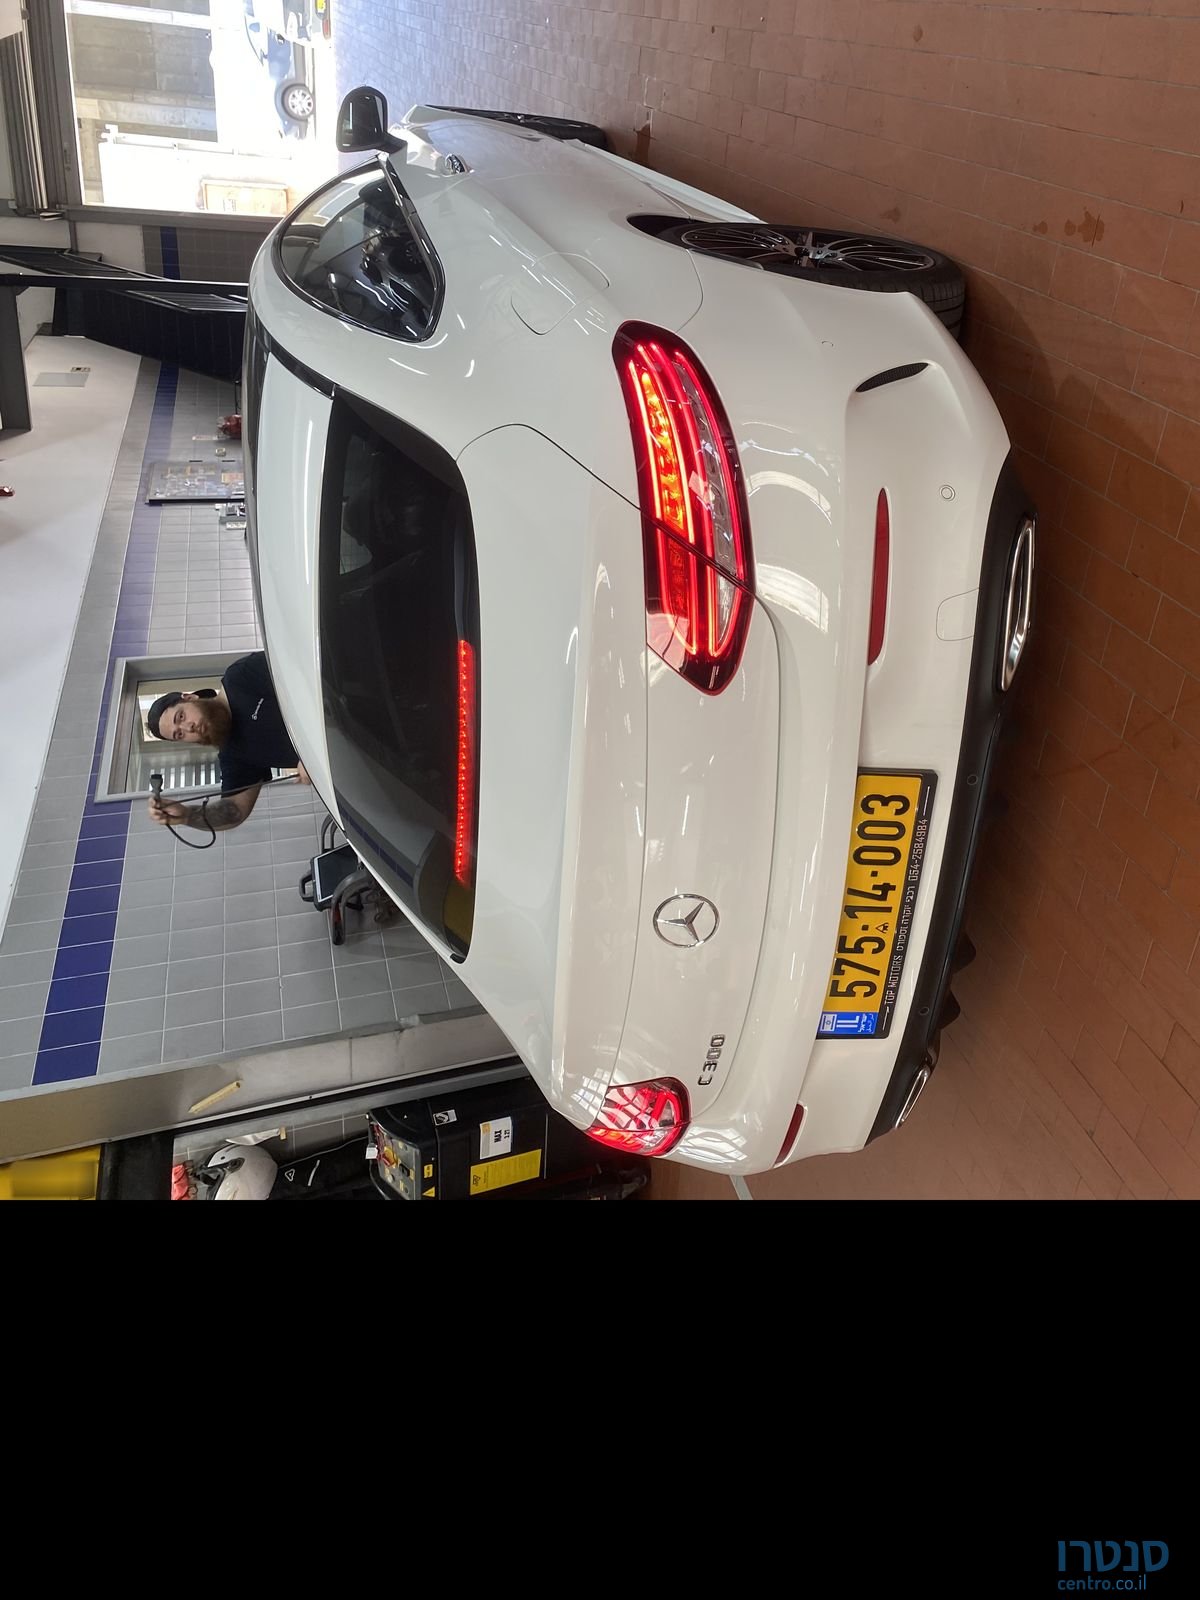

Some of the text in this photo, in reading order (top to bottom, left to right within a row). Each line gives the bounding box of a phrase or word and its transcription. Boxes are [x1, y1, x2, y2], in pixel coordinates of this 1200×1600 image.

[908, 819, 928, 882] 054-2584984
[895, 886, 916, 951] רכבי יוקרה וספורט
[883, 955, 904, 1006] TOP MOTORS
[836, 1015, 860, 1029] IL
[697, 1033, 726, 1086] C 300
[493, 1129, 502, 1143] MAX
